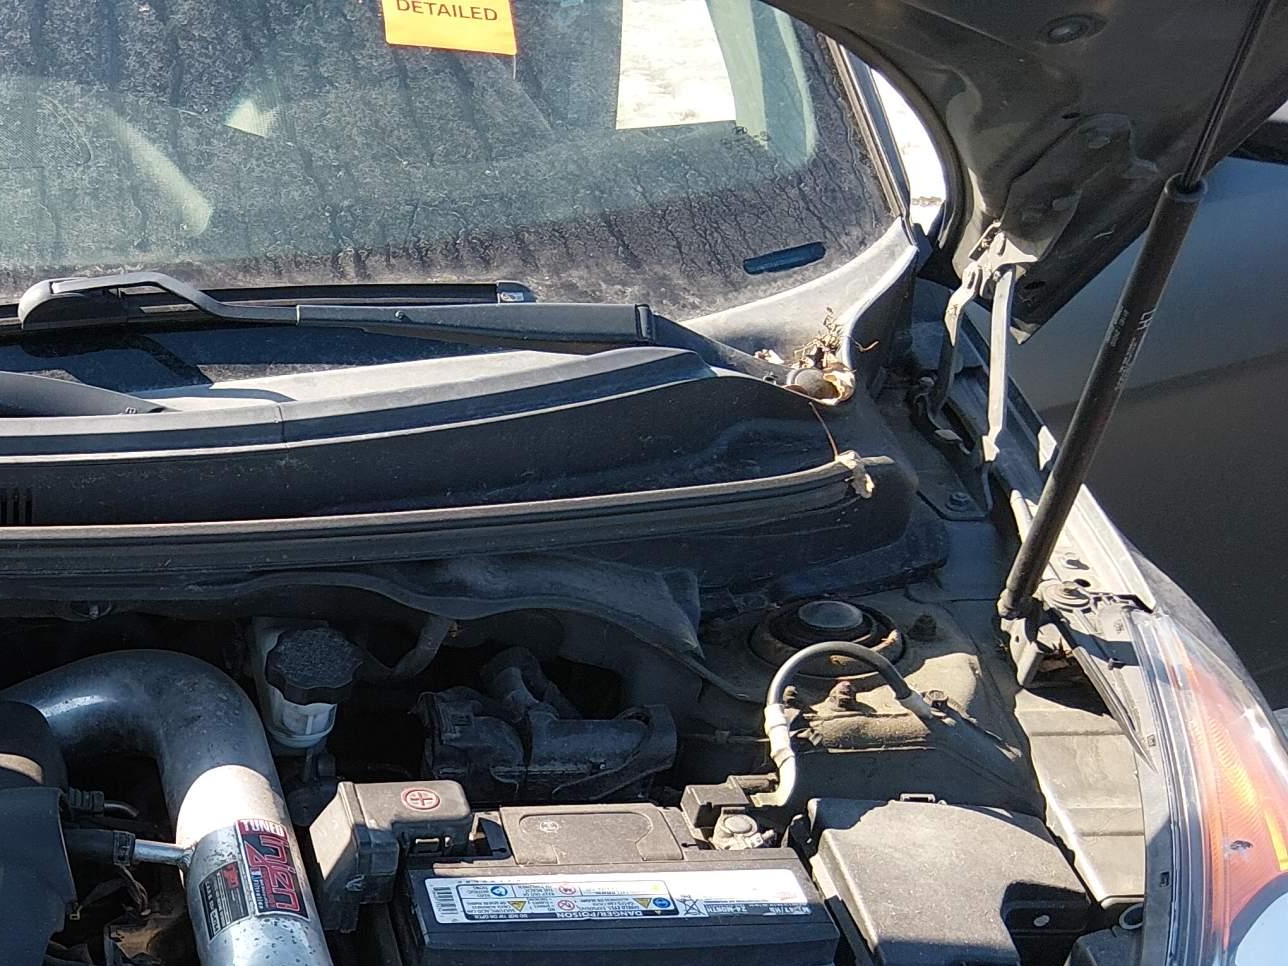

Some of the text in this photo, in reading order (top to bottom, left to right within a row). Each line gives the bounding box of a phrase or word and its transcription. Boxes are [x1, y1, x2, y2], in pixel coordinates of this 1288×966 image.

[396, 0, 498, 20] DETAILED
[244, 820, 286, 838] TUNED
[556, 911, 643, 919] DANGER/POISON
